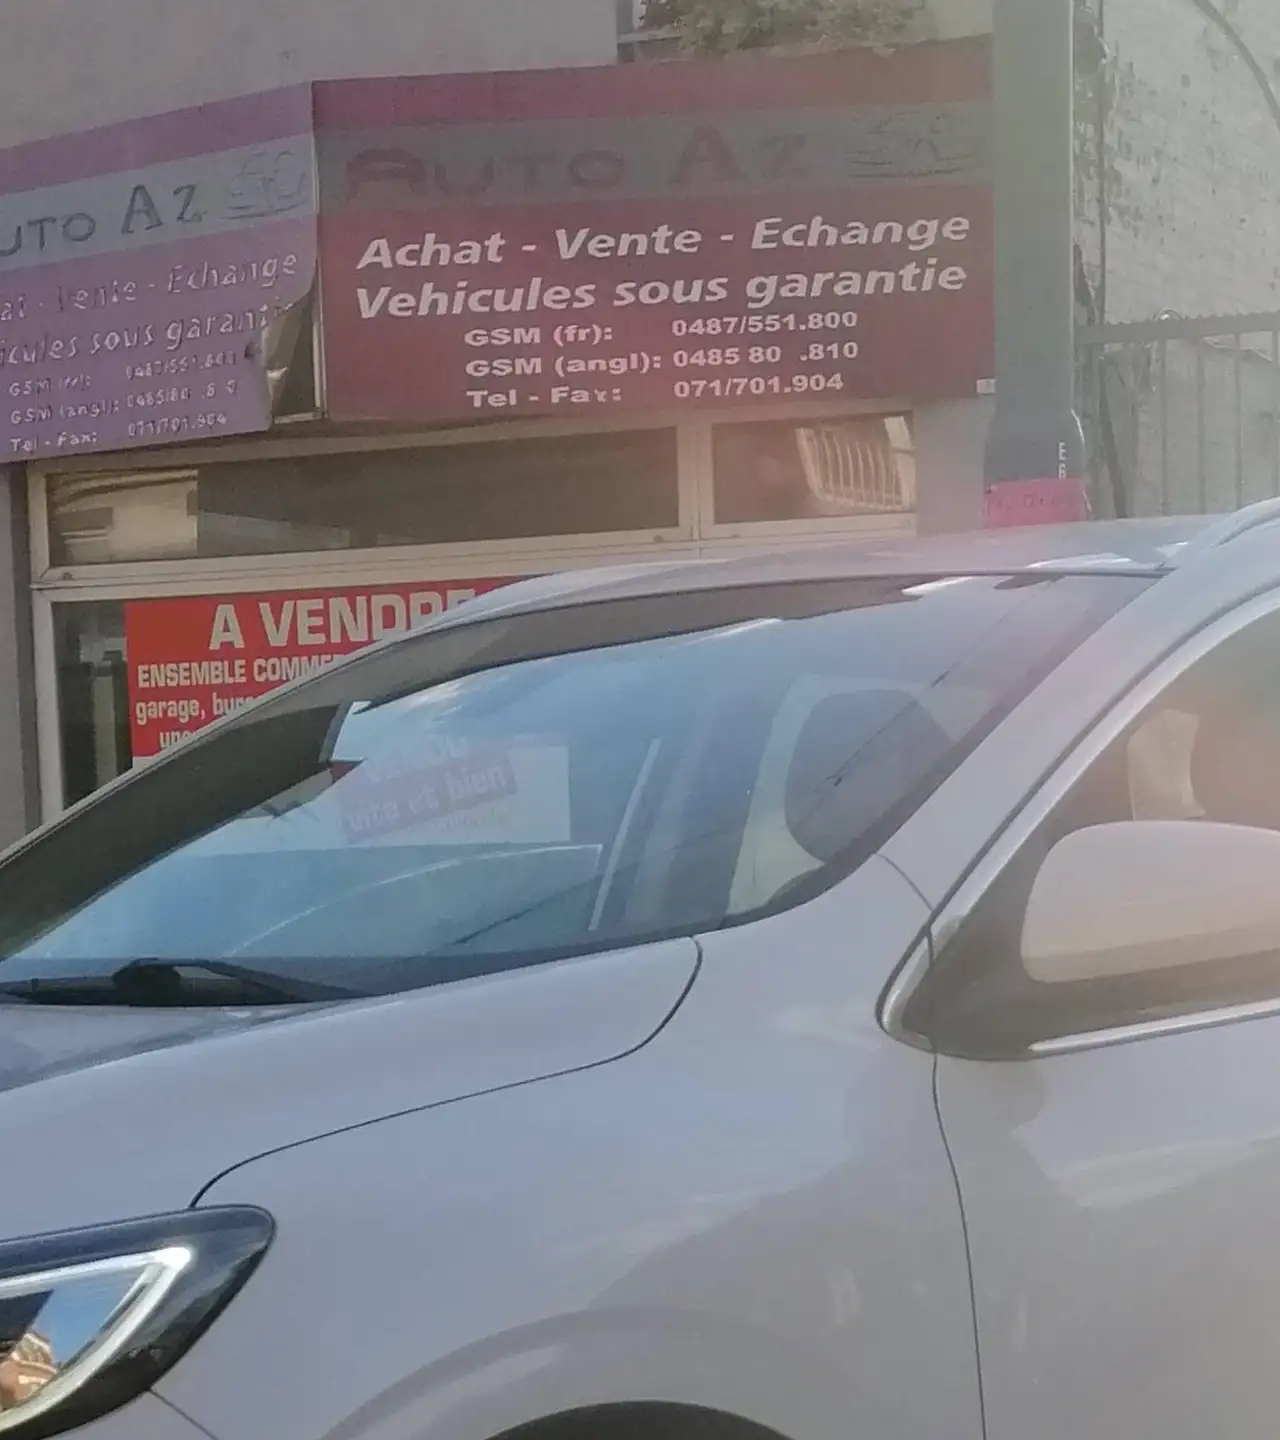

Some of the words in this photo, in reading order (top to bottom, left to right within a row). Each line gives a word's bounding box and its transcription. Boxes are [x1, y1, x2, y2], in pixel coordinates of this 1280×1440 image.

[356, 232, 506, 269] Achat
[555, 224, 702, 259] Vente
[752, 215, 969, 251] Echange
[356, 277, 595, 318] Vehicules
[613, 279, 728, 306] sous
[746, 258, 966, 309] garantie
[91, 323, 154, 354] sous
[464, 327, 541, 346] GSM
[553, 325, 612, 346] (fr):
[672, 311, 858, 336] 0487/551.800
[465, 357, 541, 377] GSM
[555, 352, 661, 377] (angl):
[673, 347, 740, 367] 0485
[466, 389, 517, 407] Tel
[674, 372, 843, 397] 071/701.904
[209, 604, 245, 650] A
[138, 660, 247, 688] ENSEMBLE
[136, 697, 206, 725] garage,
